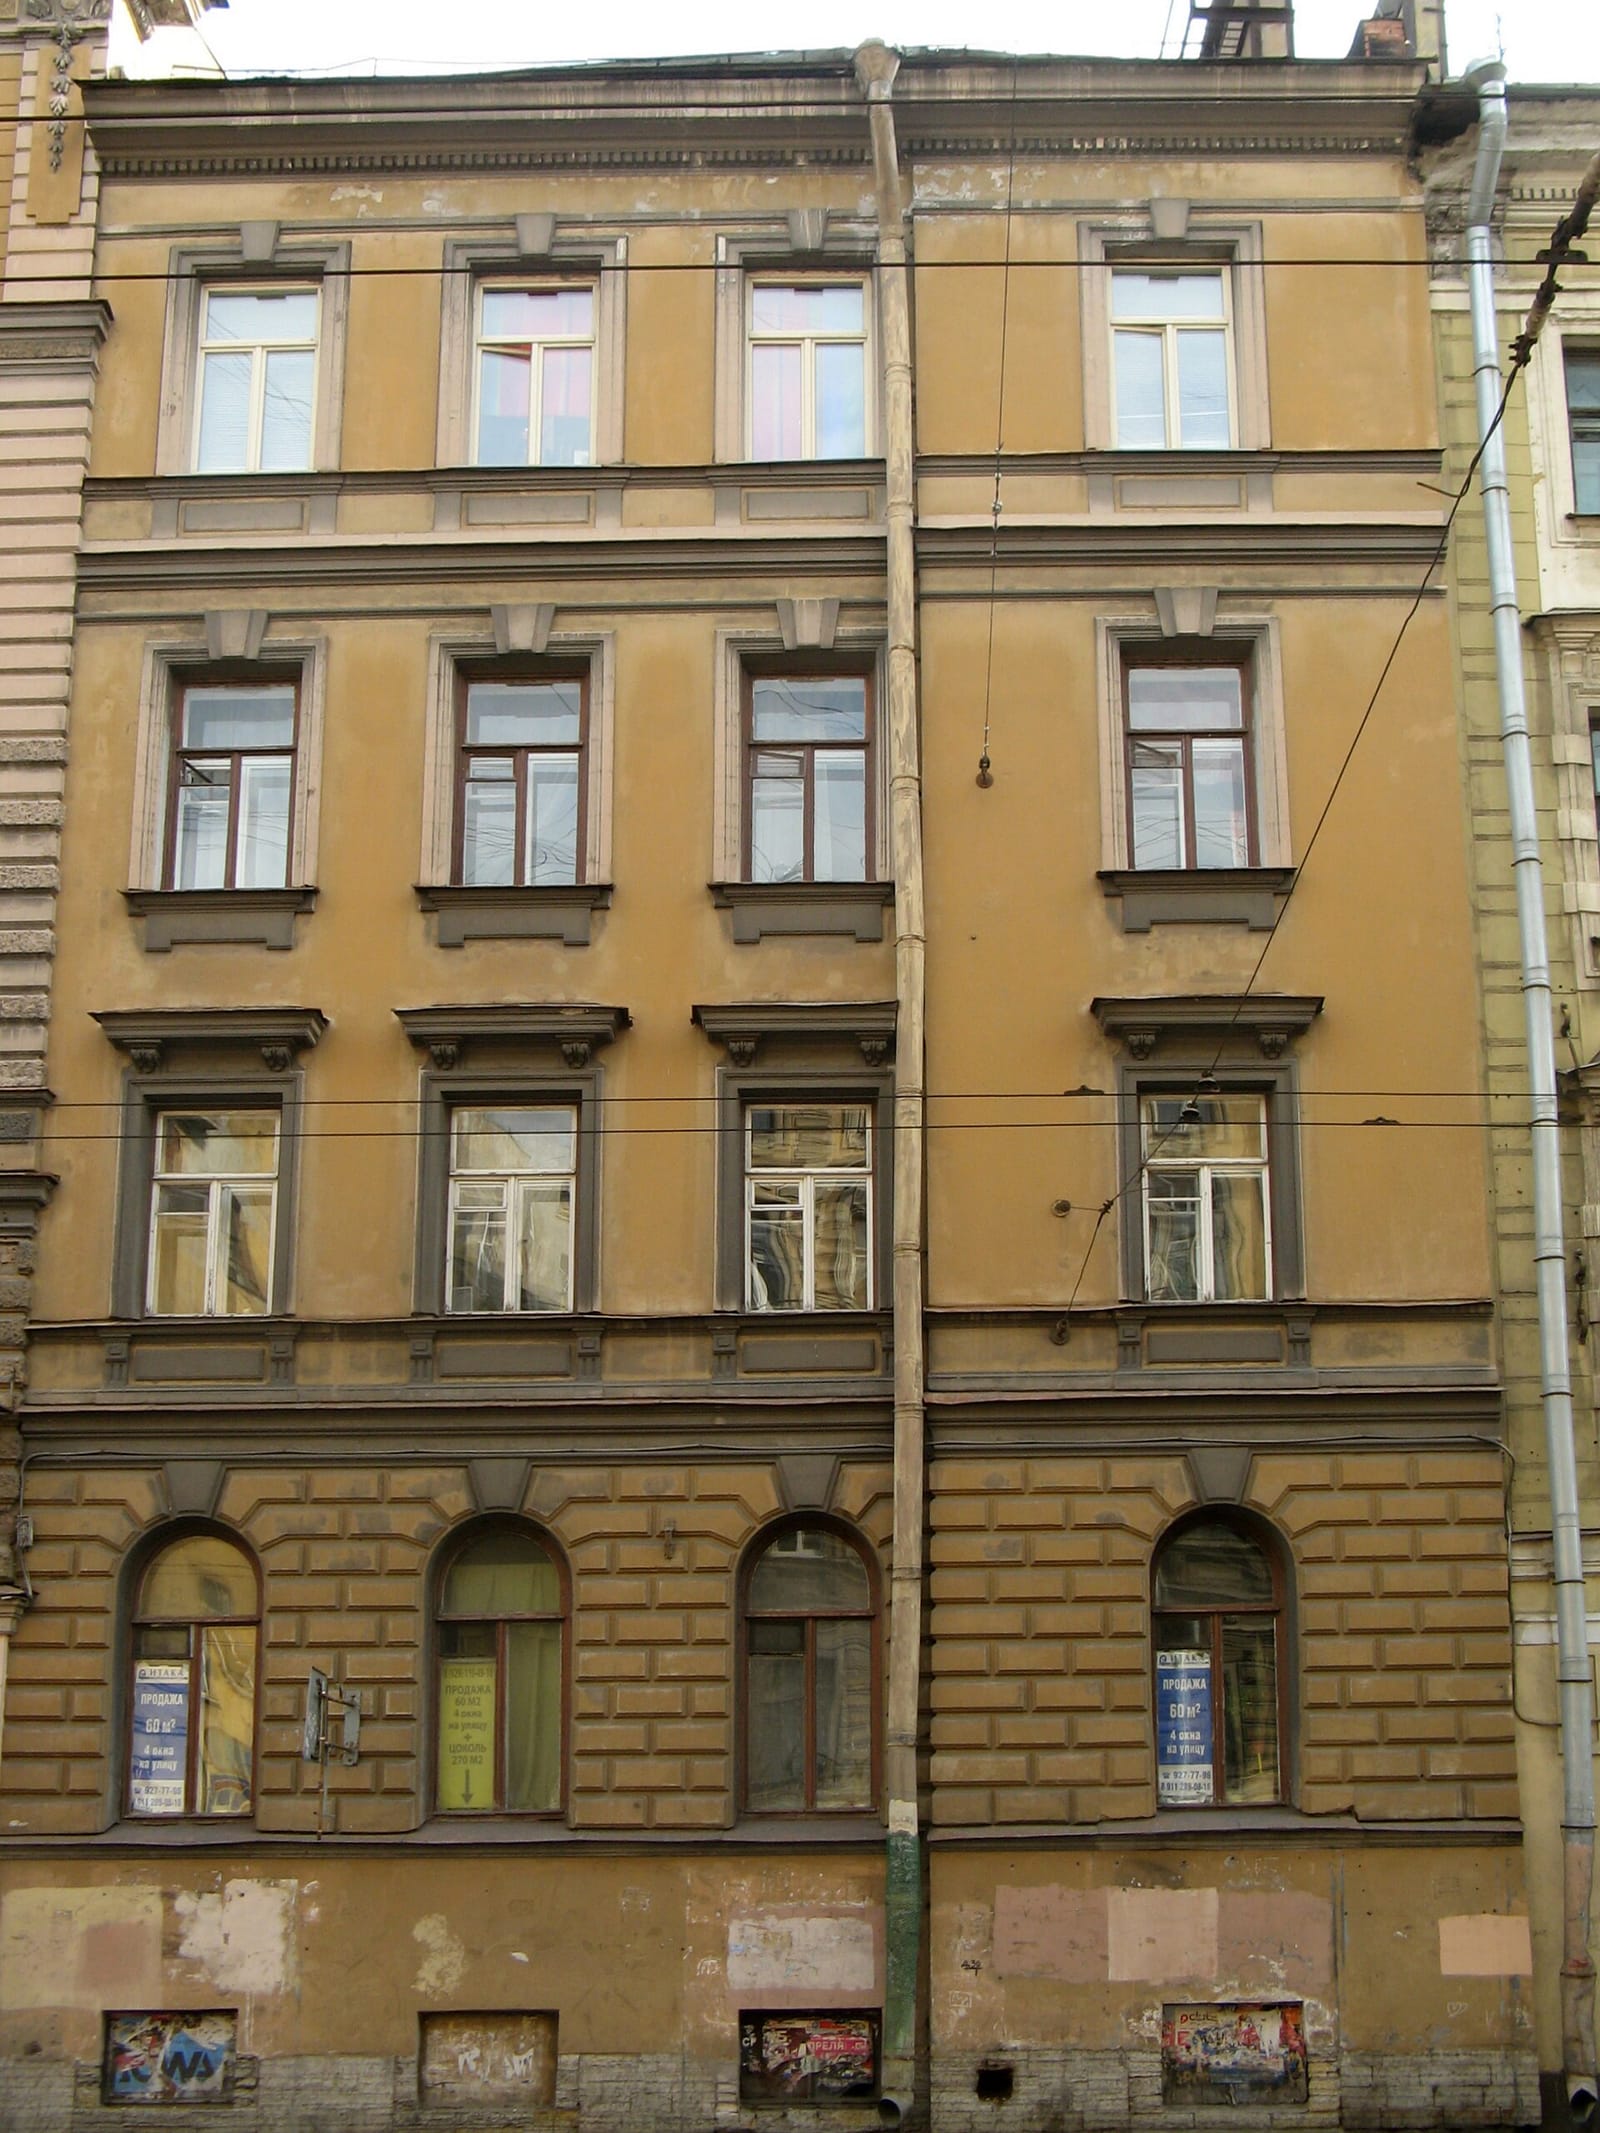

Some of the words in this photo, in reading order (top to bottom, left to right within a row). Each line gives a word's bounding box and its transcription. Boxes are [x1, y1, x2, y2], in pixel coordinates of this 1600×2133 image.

[445, 1685, 491, 1696] ПРОДАЖА
[1162, 1678, 1207, 1691] ПРОДАЖА
[141, 1693, 183, 1707] ПРОДАЖА
[1169, 1703, 1185, 1719] 60
[145, 1718, 160, 1733] 60
[1169, 1729, 1177, 1741] 4
[1179, 1731, 1201, 1741] окна
[143, 1744, 150, 1755] 4
[152, 1746, 175, 1756] окна
[448, 1743, 487, 1754] ЦОКОЛЬ
[1166, 1744, 1177, 1754] на
[1179, 1744, 1206, 1756] улицу
[151, 1760, 177, 1772] улицу
